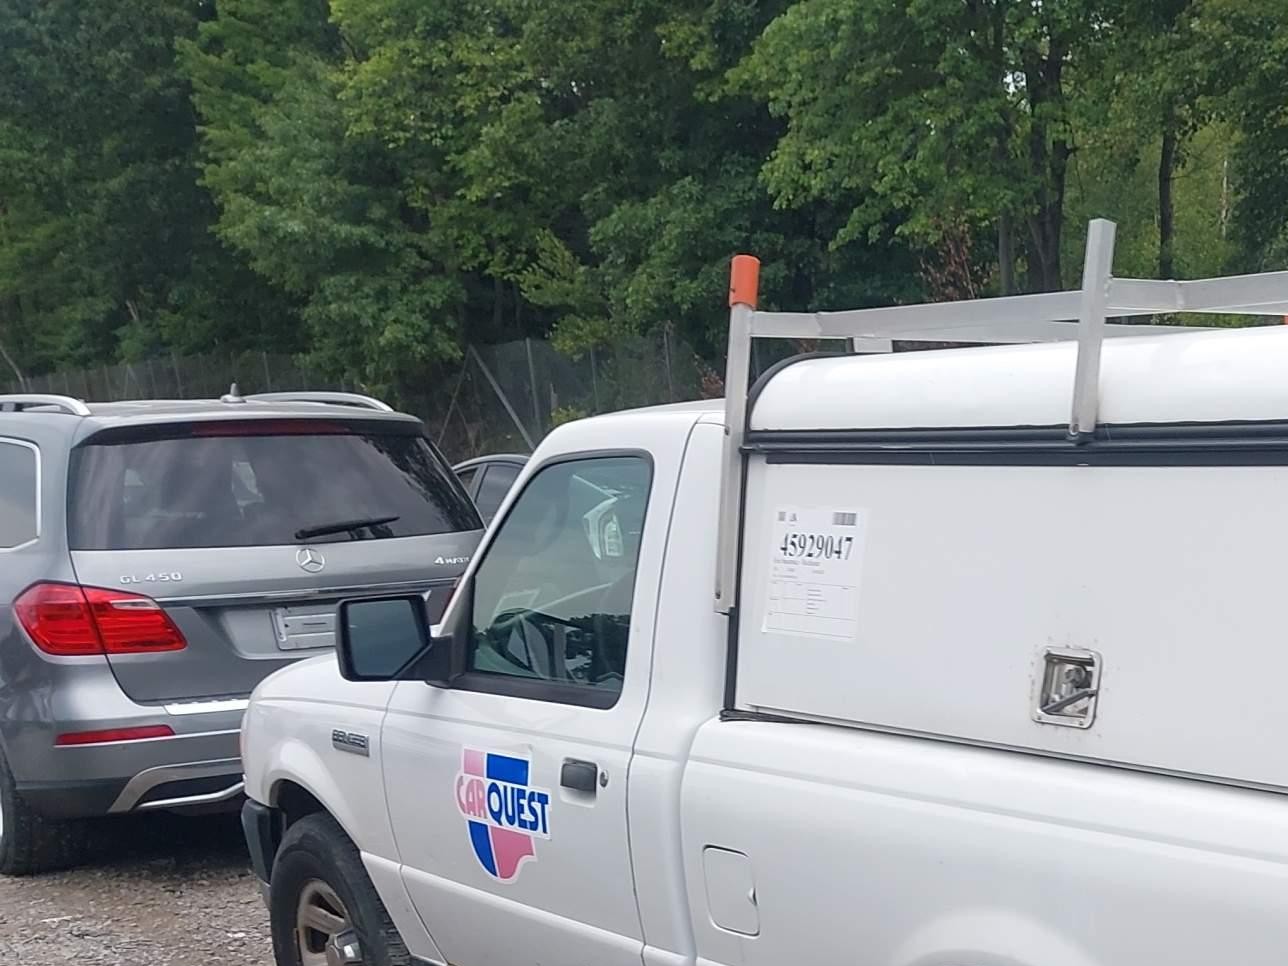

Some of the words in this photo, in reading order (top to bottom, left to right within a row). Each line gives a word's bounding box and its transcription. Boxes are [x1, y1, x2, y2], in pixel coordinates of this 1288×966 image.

[780, 533, 853, 561] 45929047
[119, 575, 141, 584] GL
[144, 572, 182, 582] 450
[456, 774, 549, 834] CARQUEST
